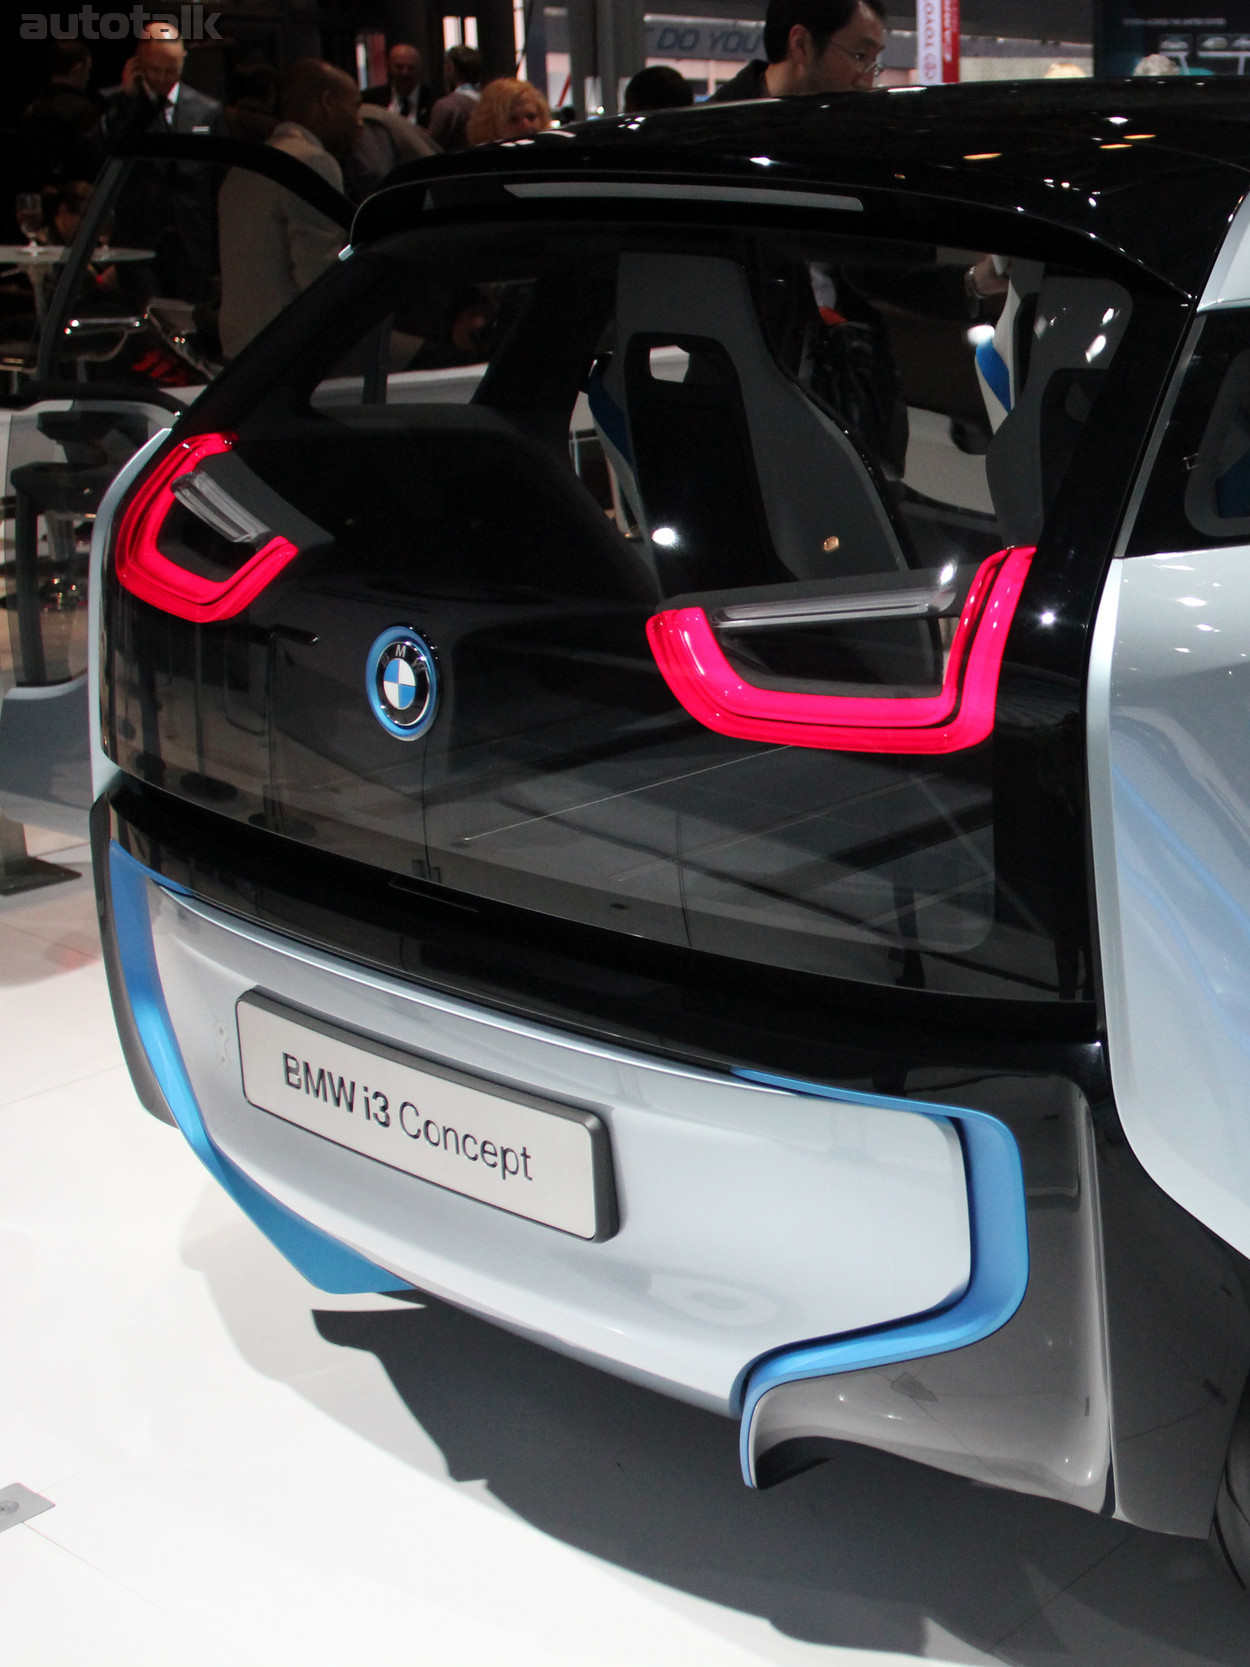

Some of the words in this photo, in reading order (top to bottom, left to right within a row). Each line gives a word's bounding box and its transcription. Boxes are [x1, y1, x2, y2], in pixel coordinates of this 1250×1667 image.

[657, 28, 699, 50] DO
[709, 30, 762, 53] YOU
[282, 1052, 355, 1113] BMW
[363, 1085, 390, 1128] i3
[399, 1101, 533, 1181] Concept
